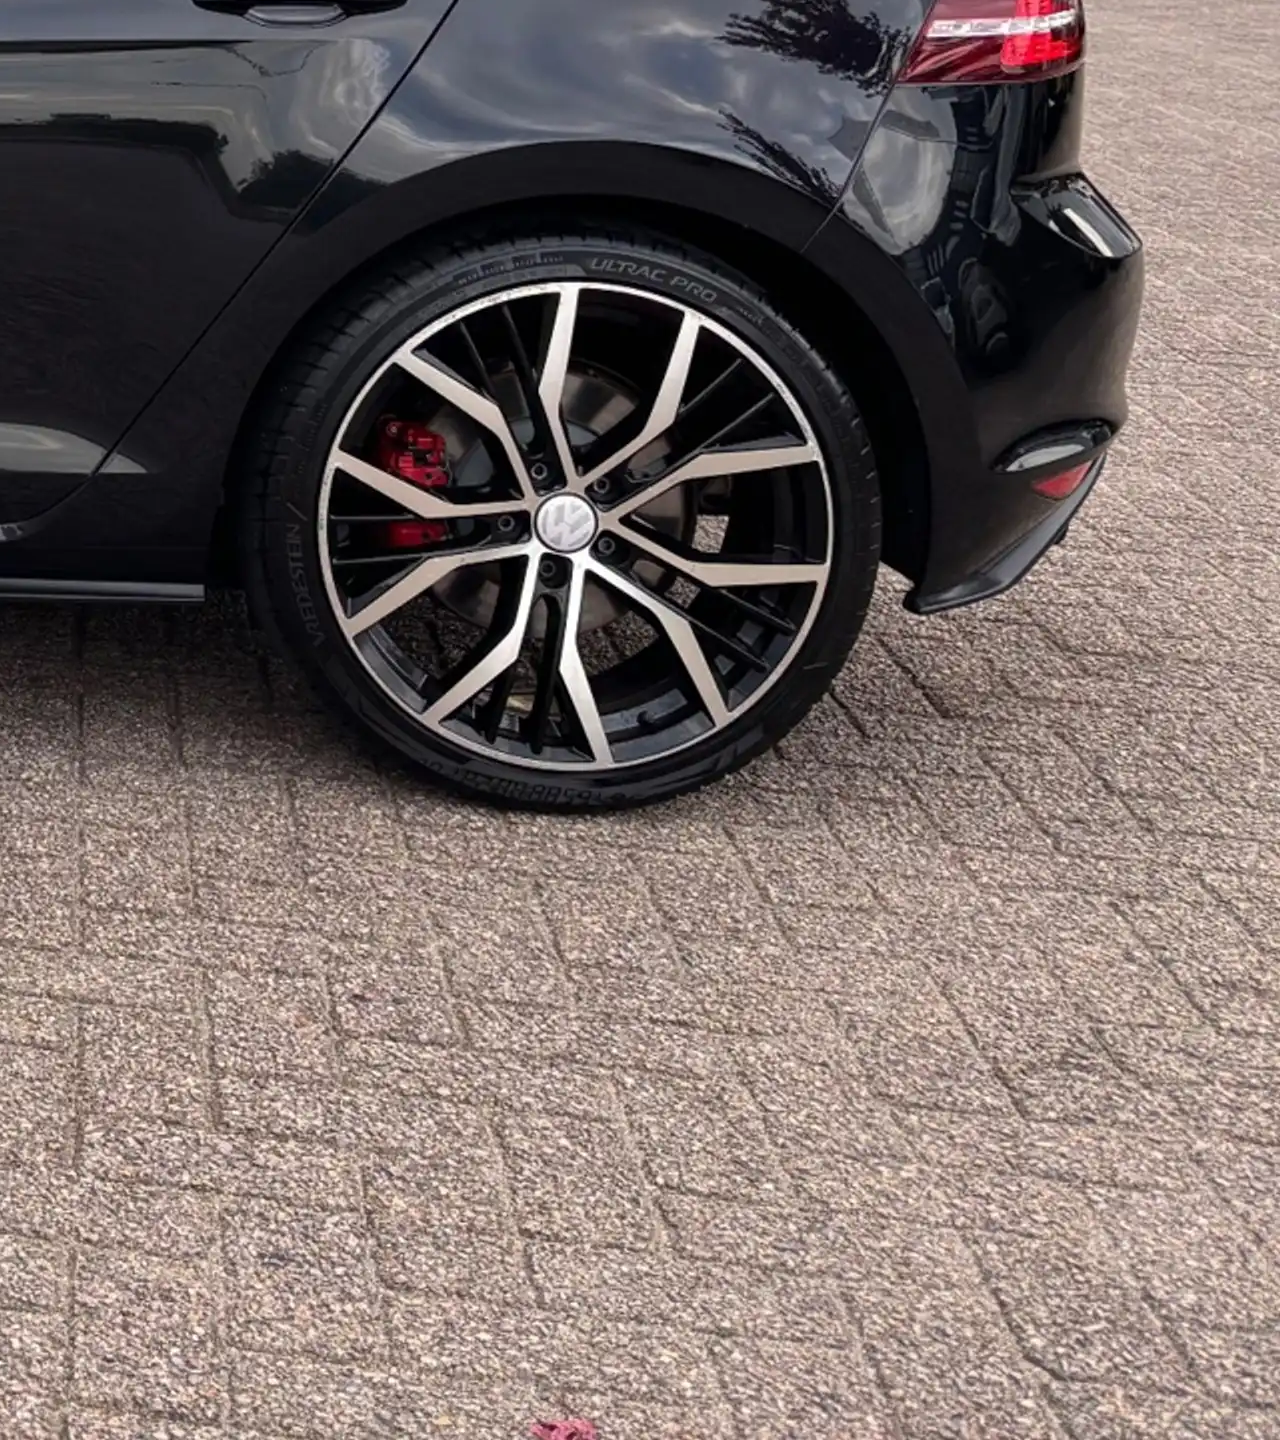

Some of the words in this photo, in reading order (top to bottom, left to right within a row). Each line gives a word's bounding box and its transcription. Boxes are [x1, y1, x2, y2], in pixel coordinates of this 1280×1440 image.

[591, 256, 668, 282] ULTRAC
[670, 274, 718, 303] PRO
[285, 523, 327, 647] VREDESTEIN
